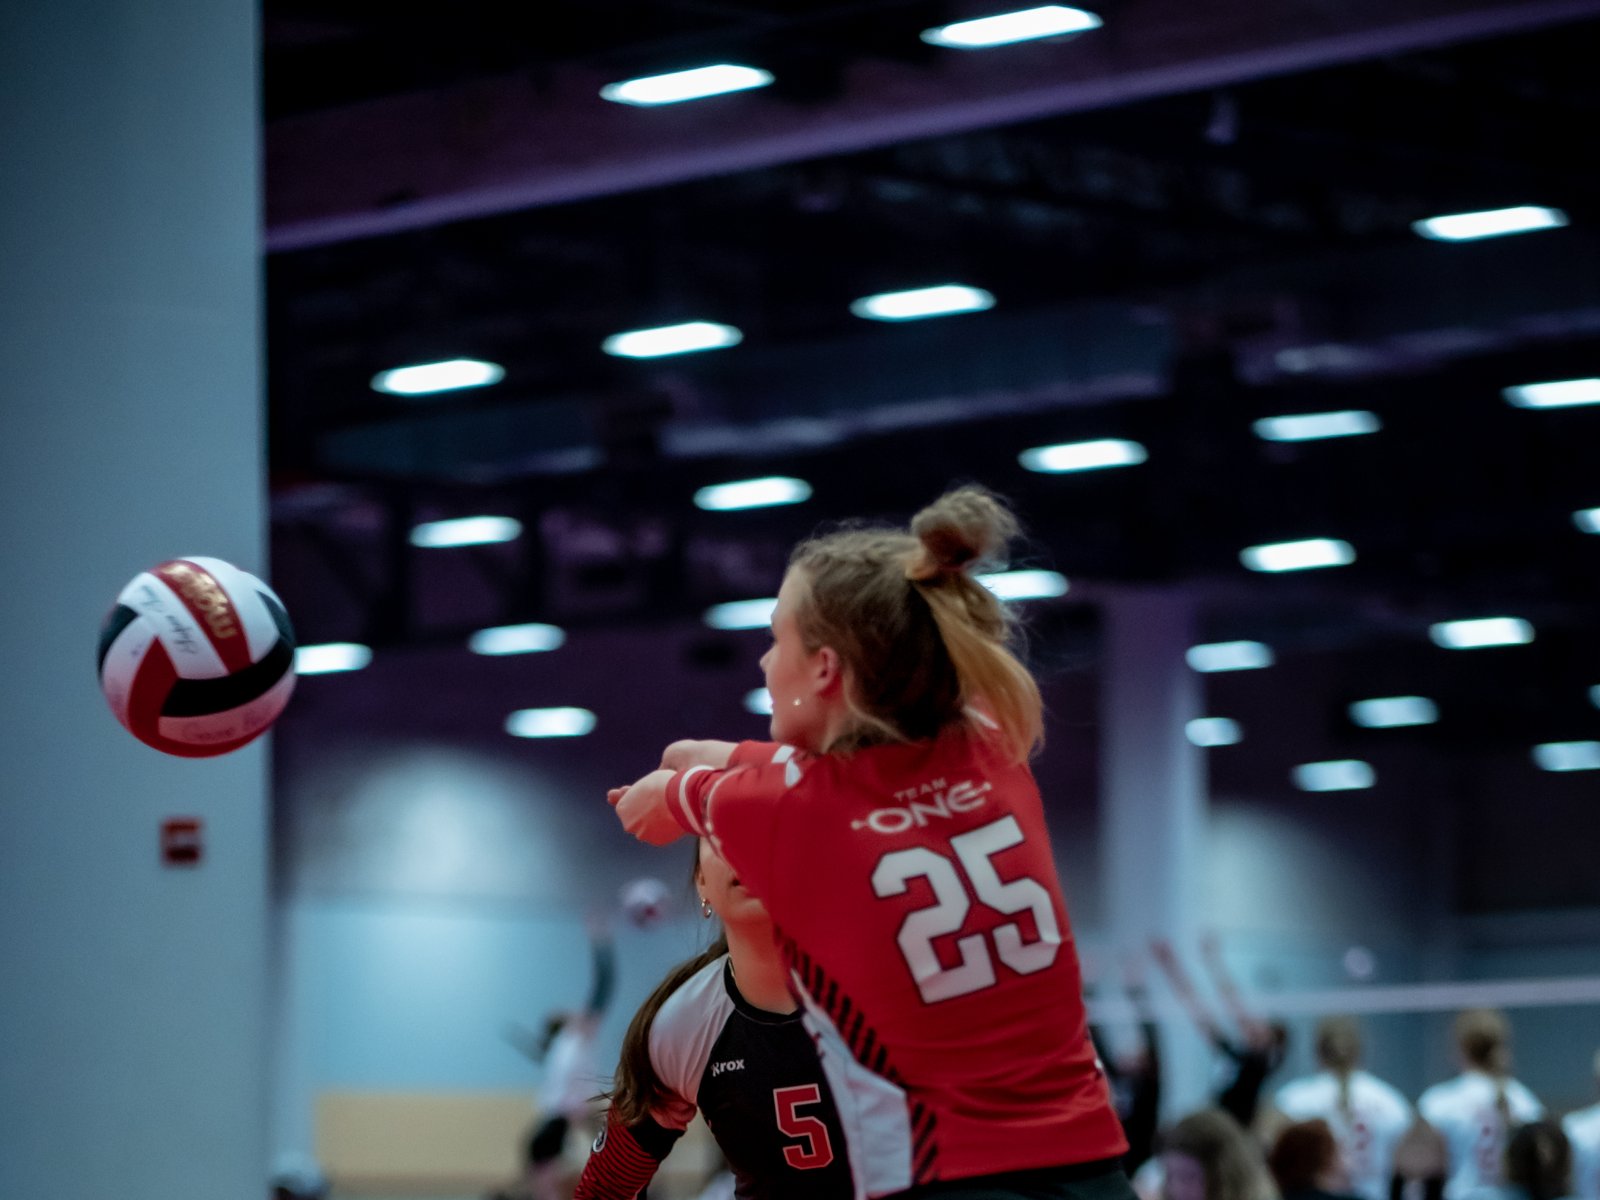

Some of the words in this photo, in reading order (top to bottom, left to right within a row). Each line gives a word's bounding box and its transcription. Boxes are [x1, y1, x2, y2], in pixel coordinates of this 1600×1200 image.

[866, 779, 987, 833] ONE
[893, 777, 947, 801] TEAM
[871, 813, 1062, 1004] 25
[773, 1083, 834, 1170] 5
